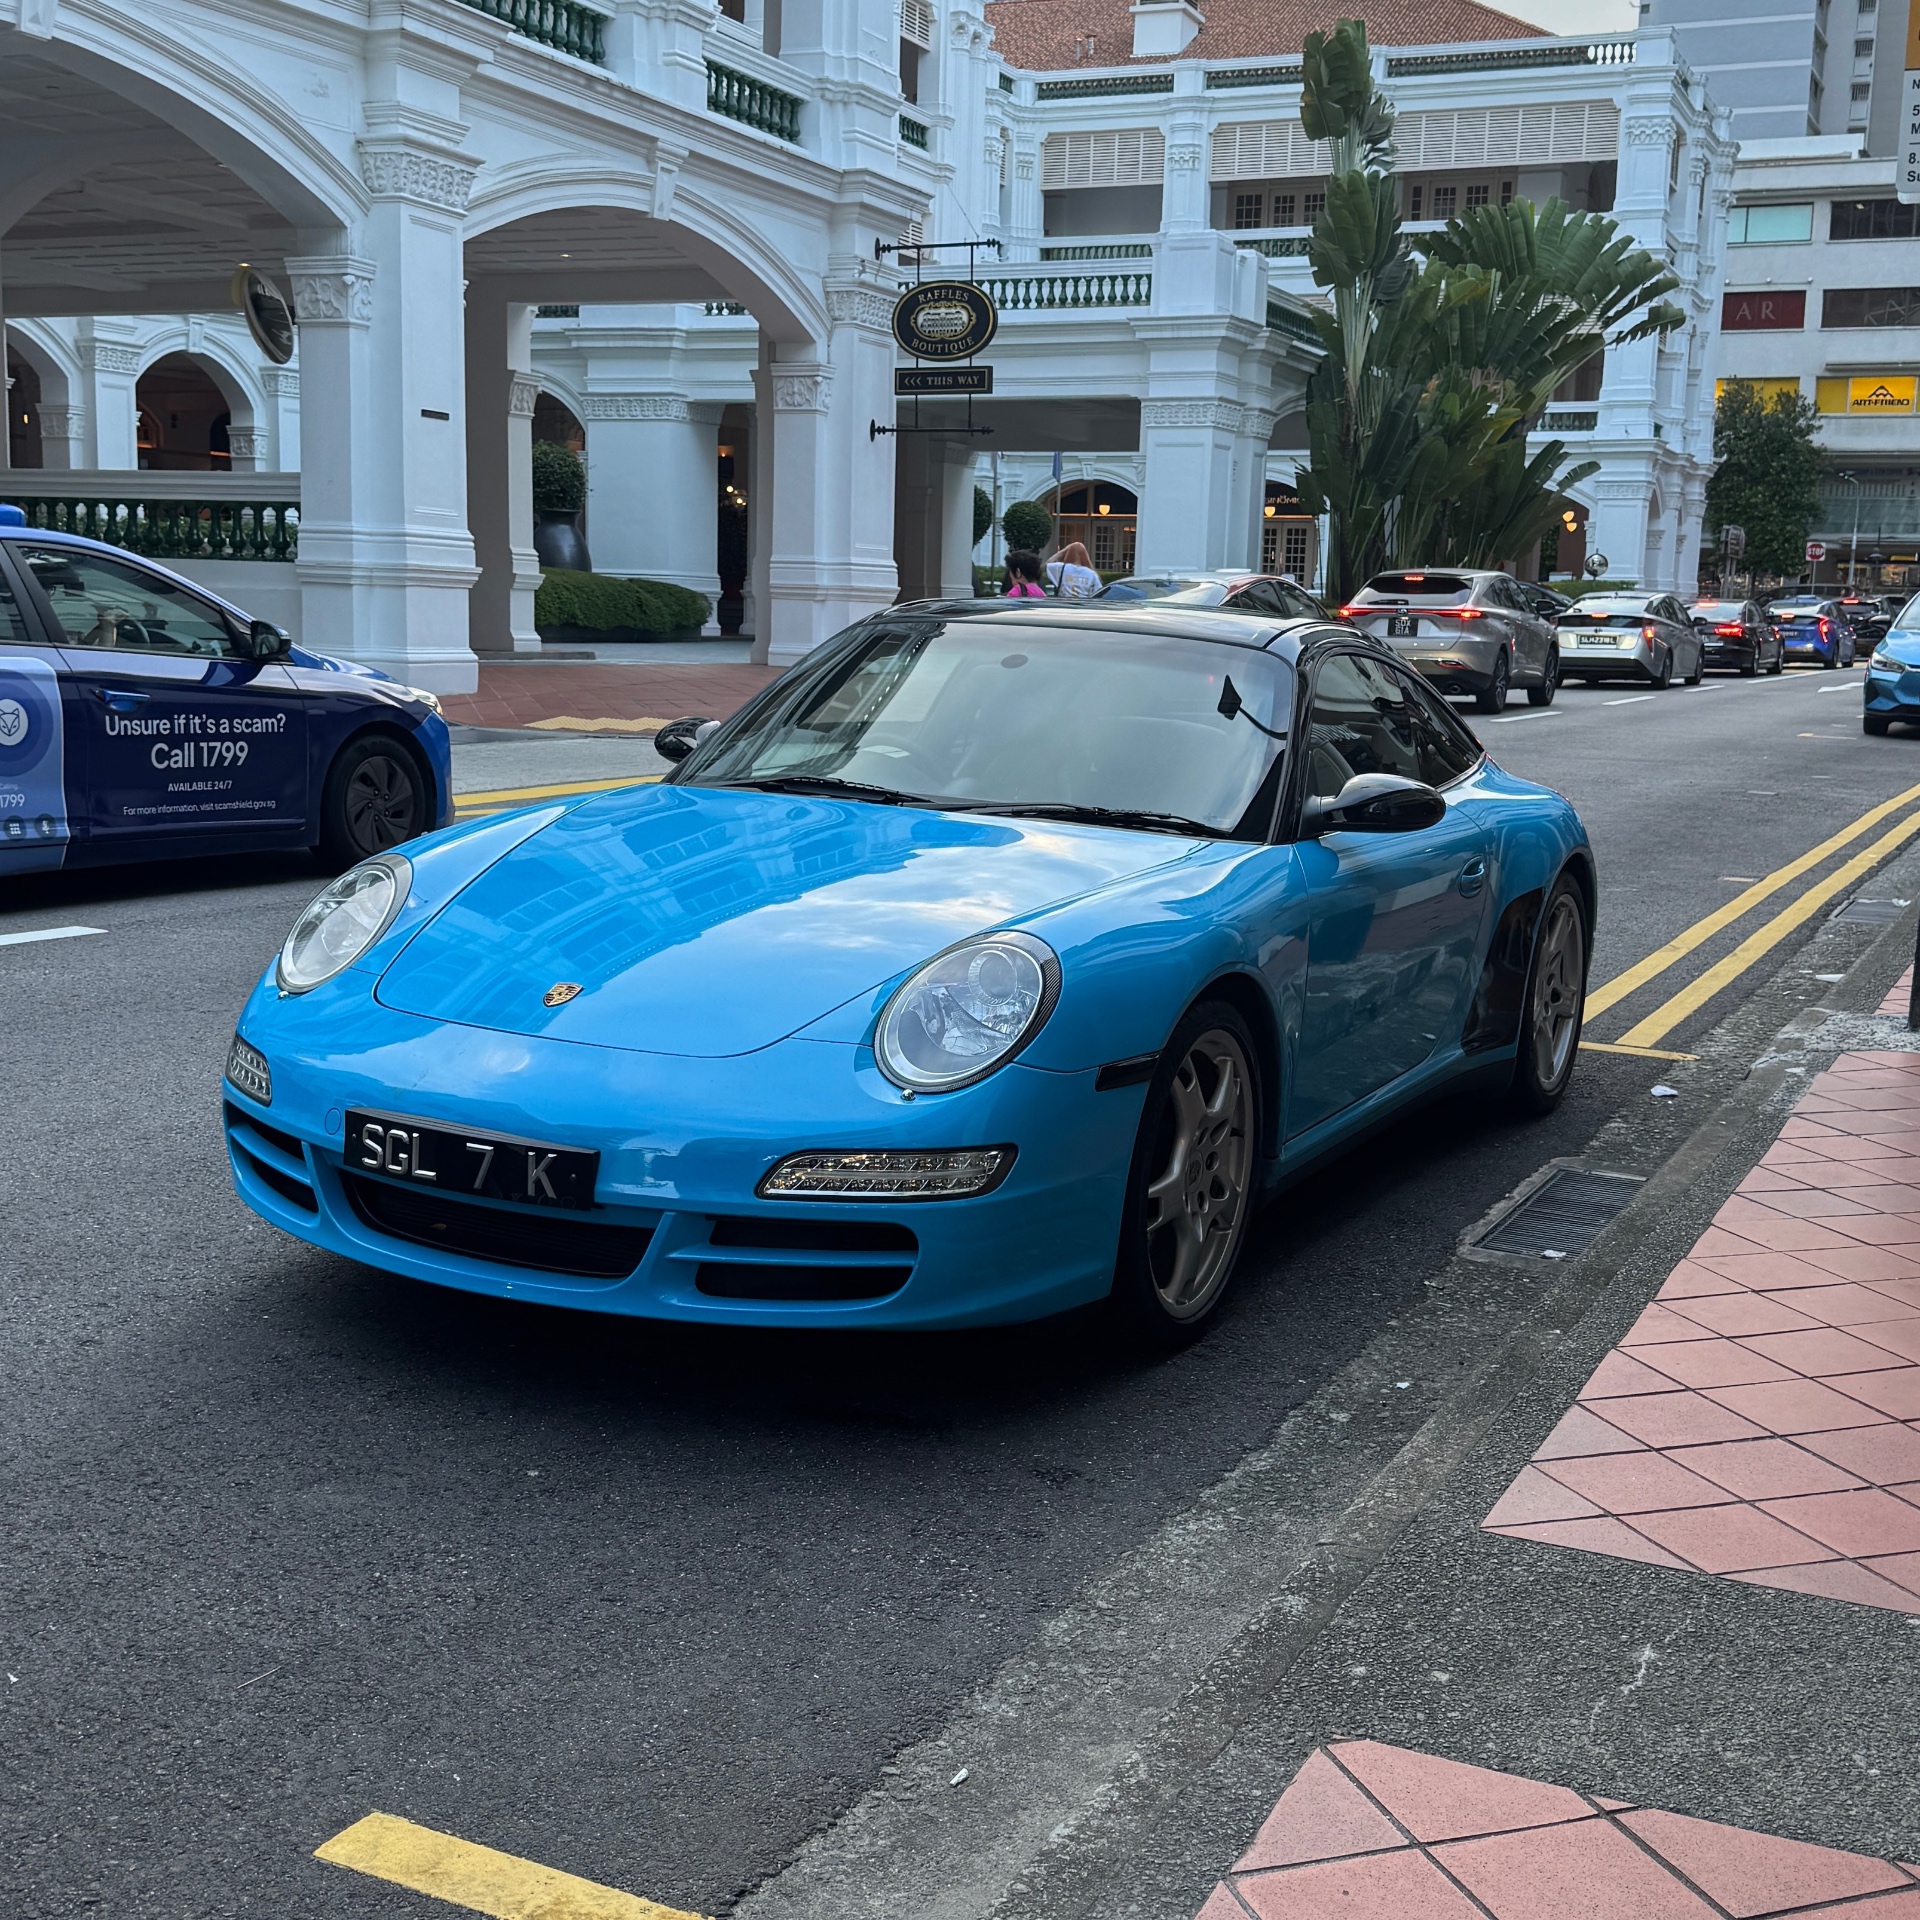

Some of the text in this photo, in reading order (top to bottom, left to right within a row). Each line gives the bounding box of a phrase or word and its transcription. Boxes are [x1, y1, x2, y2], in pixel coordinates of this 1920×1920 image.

[918, 289, 970, 304] RAFFLES
[911, 336, 975, 353] BOUTIQUE
[926, 375, 980, 385] THIS WAY
[1807, 547, 1824, 556] STOP
[105, 713, 286, 736] Unsure if it's a scam?
[151, 741, 249, 769] Call 1799
[168, 780, 232, 792] AVAILABLE 24/7
[0, 793, 25, 808] 1799
[123, 800, 276, 815] For more information, visit scamshield.gov.sg
[362, 1123, 557, 1199] SGL 7 K
